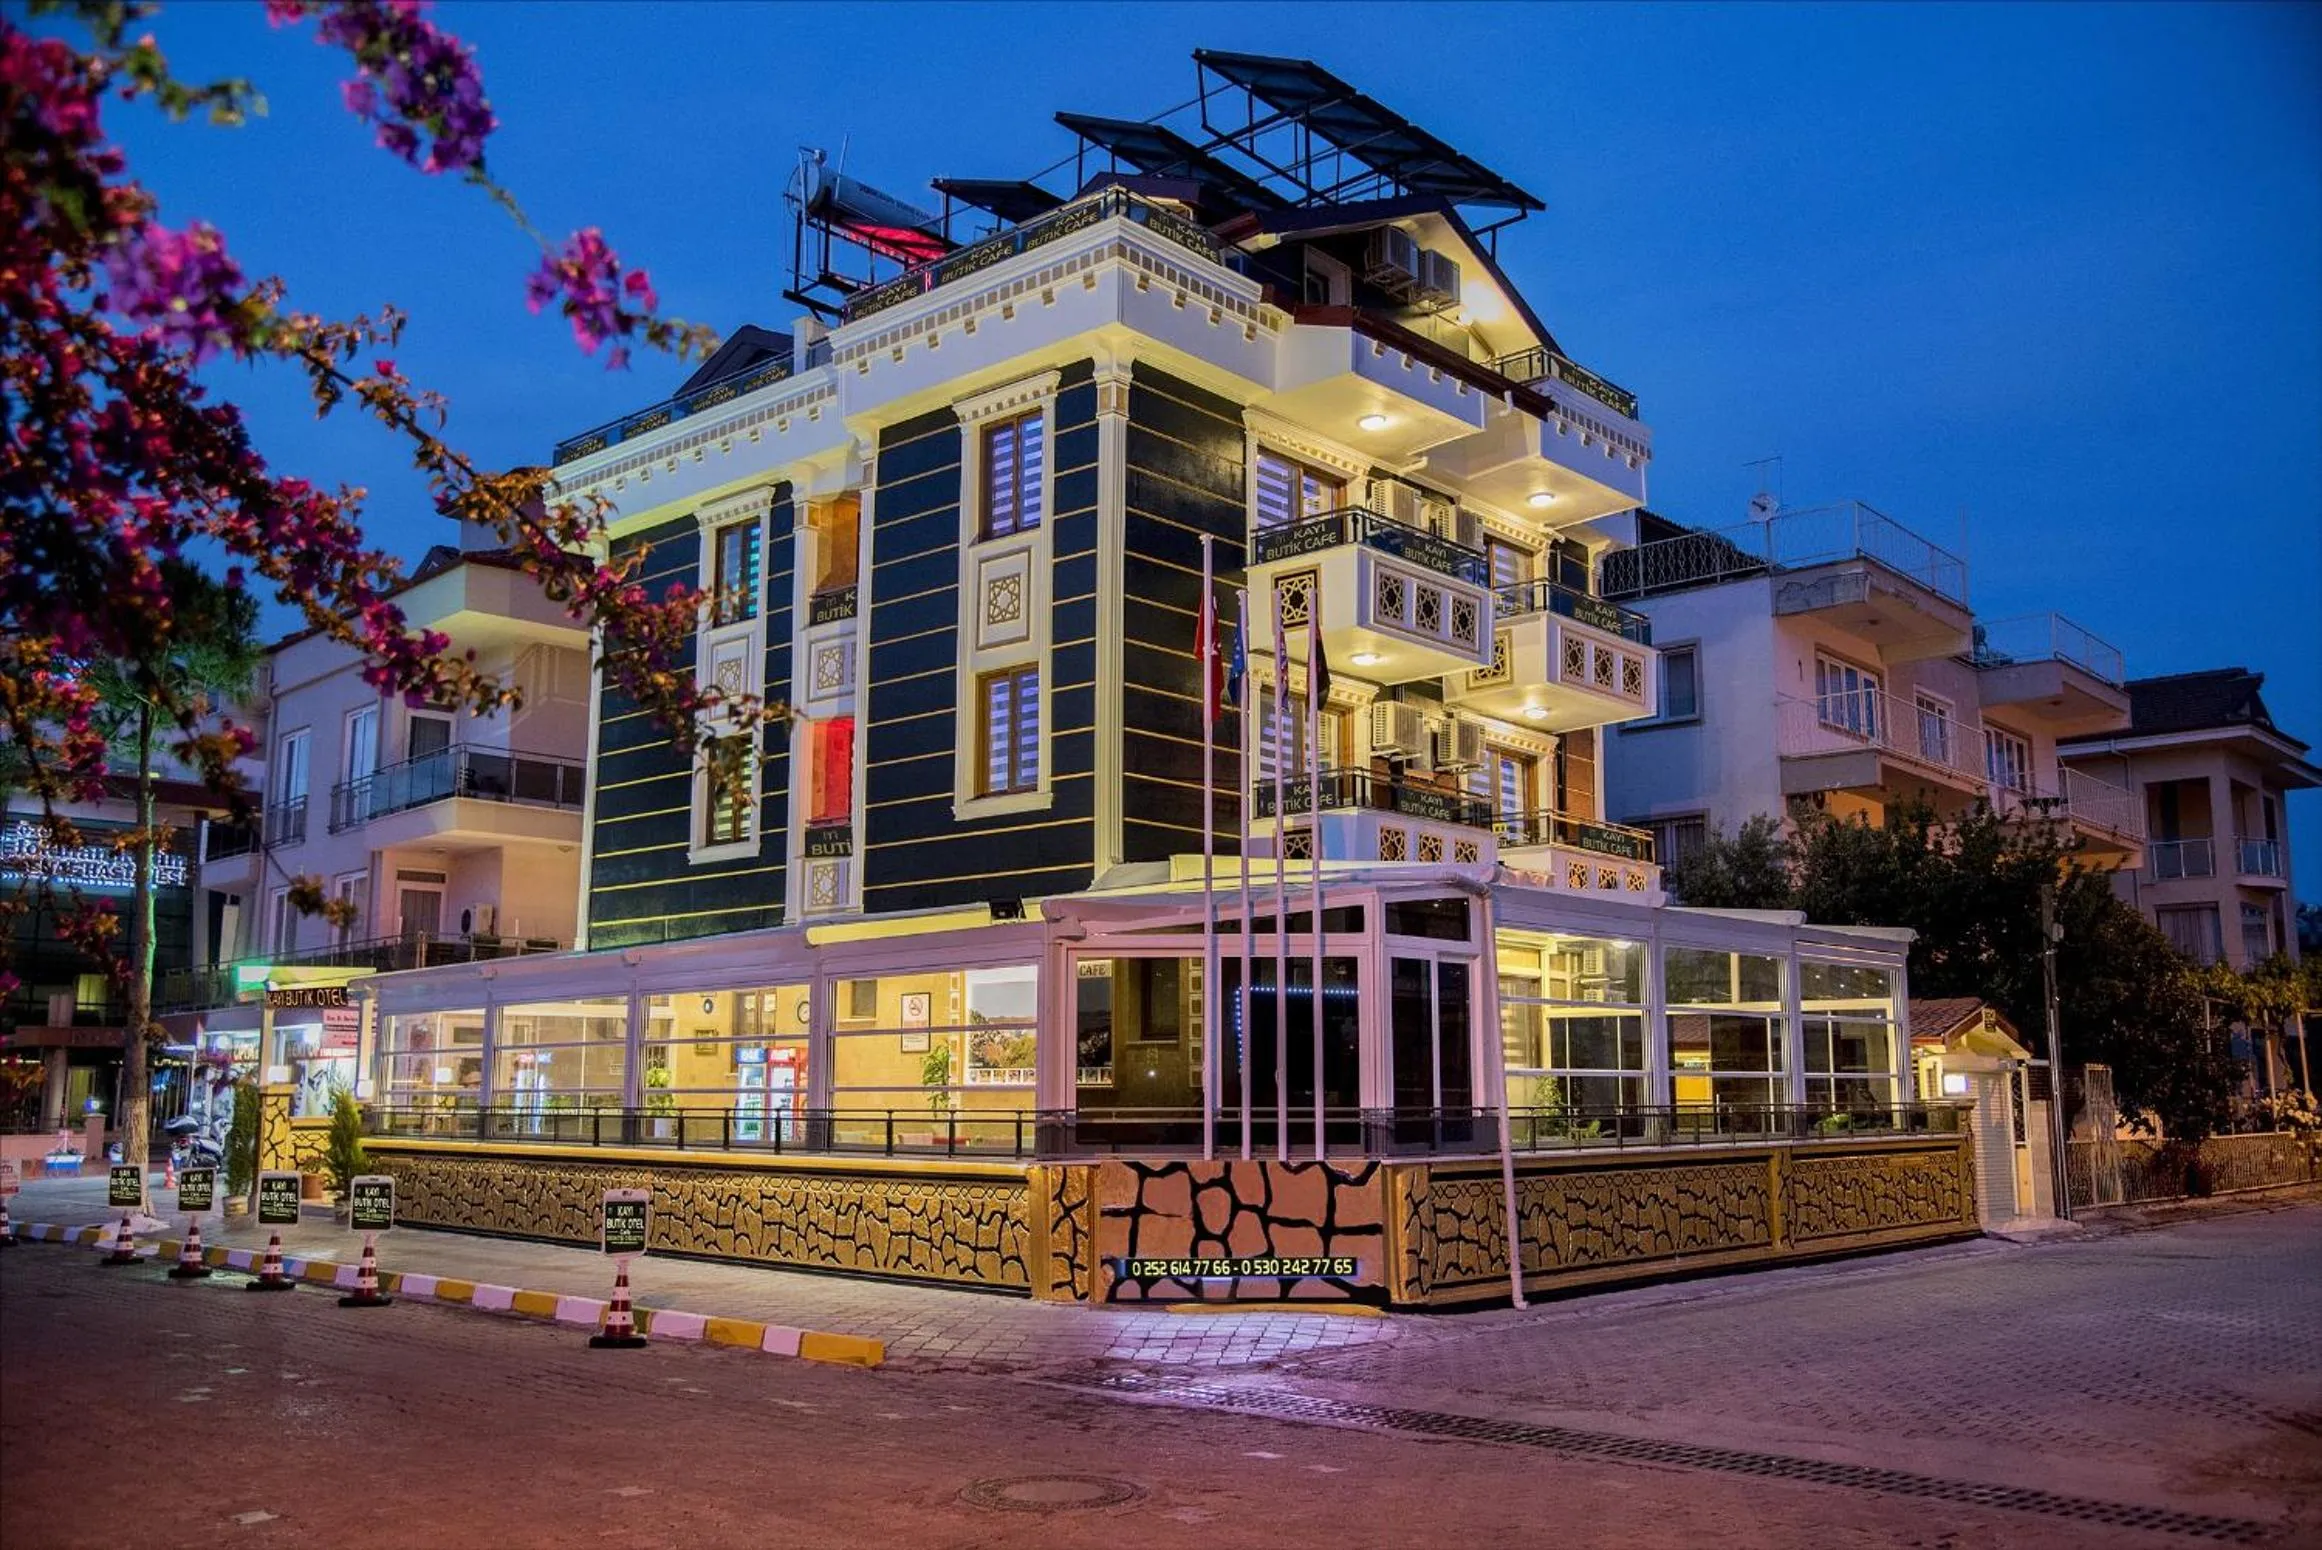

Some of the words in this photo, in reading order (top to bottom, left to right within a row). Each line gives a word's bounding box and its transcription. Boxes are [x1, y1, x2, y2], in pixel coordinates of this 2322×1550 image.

[1293, 523, 1326, 539] KAYI
[1304, 532, 1337, 549] CAFE
[1425, 544, 1447, 558] KAYI
[1431, 557, 1452, 573] CAFE
[1293, 782, 1324, 795] KAI
[1267, 797, 1301, 813] BTİK
[1304, 794, 1334, 808] CFE
[811, 839, 852, 856] BUTİ
[1080, 964, 1106, 977] CAFE
[317, 988, 347, 1006] OTEL
[1132, 1261, 1141, 1276] 0
[1143, 1261, 1167, 1276] 252
[1170, 1261, 1191, 1275] 614
[1193, 1260, 1210, 1275] 77
[1213, 1260, 1230, 1275] 66
[1241, 1260, 1251, 1275] 0
[1253, 1260, 1280, 1274] 530
[1282, 1259, 1310, 1274] 242
[1312, 1259, 1330, 1274] 77
[1333, 1258, 1352, 1274] 65
